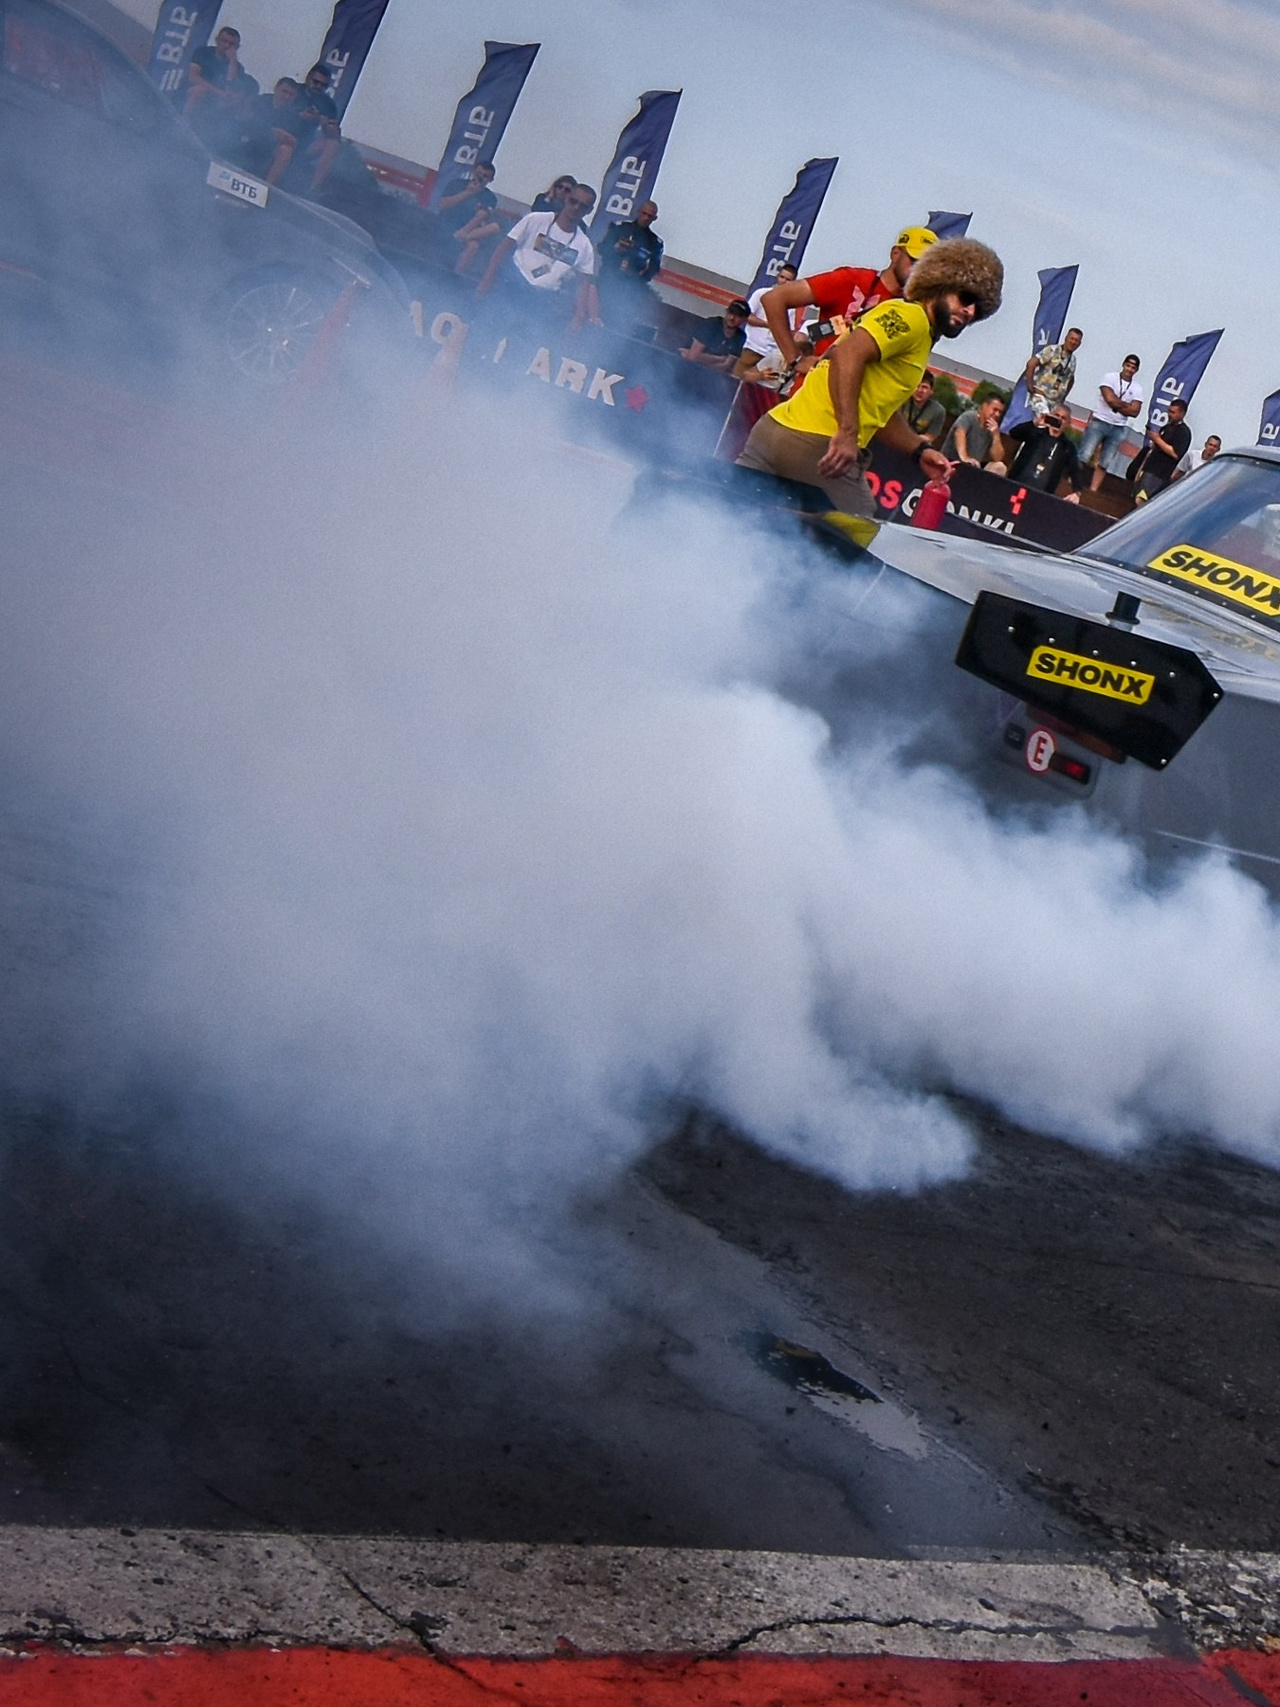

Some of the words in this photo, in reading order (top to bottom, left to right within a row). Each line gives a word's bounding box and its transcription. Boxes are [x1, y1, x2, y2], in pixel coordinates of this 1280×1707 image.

[231, 178, 257, 199] ВТБ
[1035, 652, 1147, 699] SHONX
[1033, 736, 1047, 765] E
